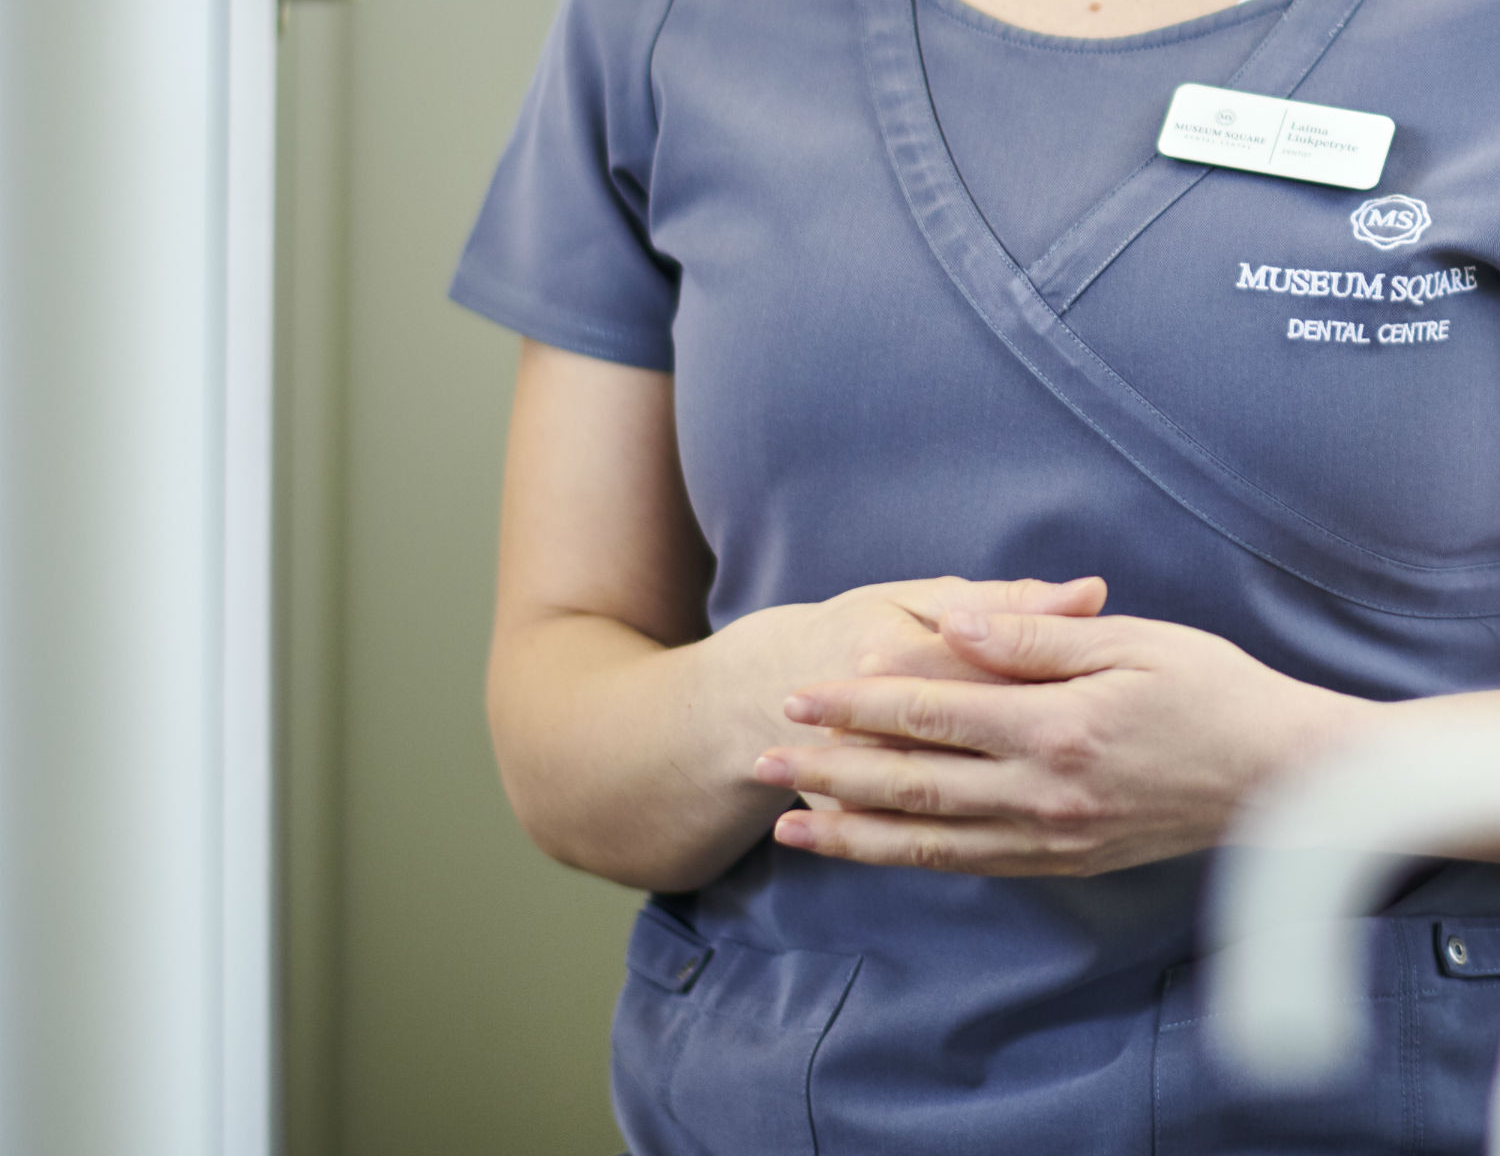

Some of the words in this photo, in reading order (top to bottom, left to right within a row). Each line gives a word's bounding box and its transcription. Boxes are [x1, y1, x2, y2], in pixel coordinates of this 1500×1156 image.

[1174, 122, 1222, 137] MUSEUM
[1224, 131, 1265, 145] SQUARE
[1291, 121, 1329, 136] Laima
[1367, 209, 1415, 230] MS
[1236, 262, 1386, 300] MUSEUM
[1390, 266, 1478, 305] SQUARE
[1286, 318, 1370, 343] DENTAL
[1376, 320, 1451, 343] CENTRE
